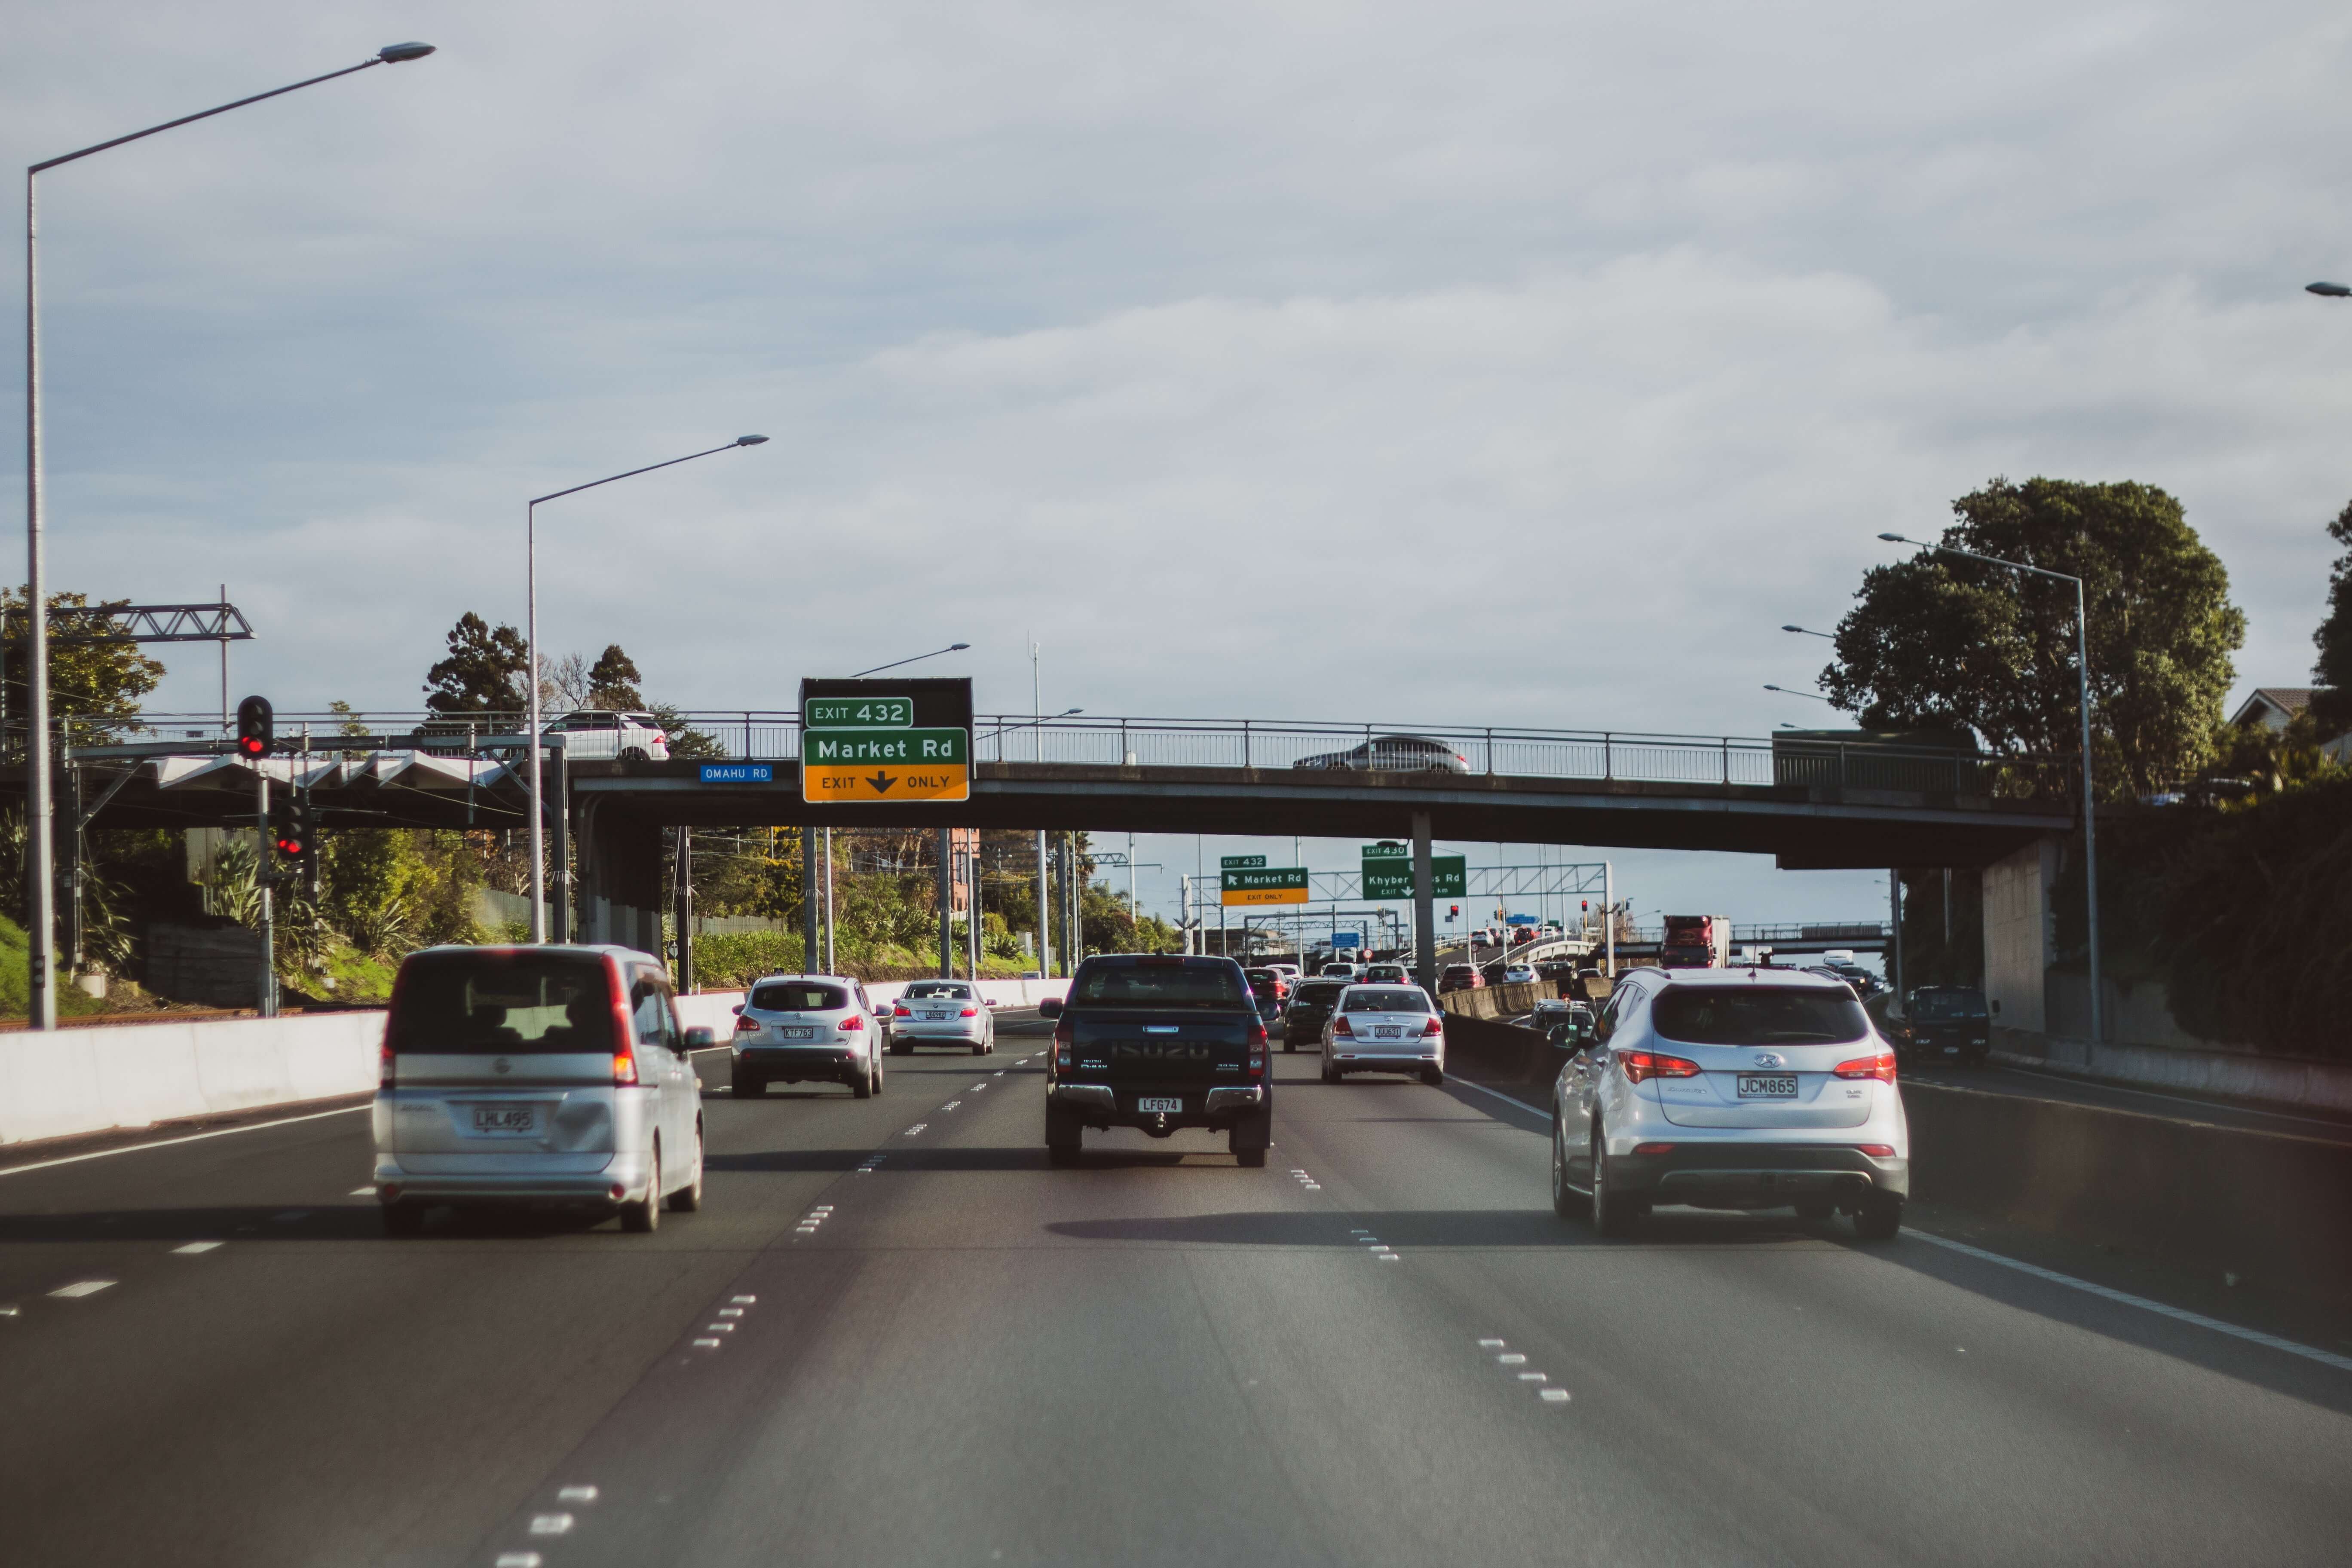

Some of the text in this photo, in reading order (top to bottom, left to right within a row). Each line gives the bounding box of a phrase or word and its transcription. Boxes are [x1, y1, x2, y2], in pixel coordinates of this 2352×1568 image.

[815, 704, 903, 721] EXIT 432
[819, 739, 952, 758] Market Rd
[706, 769, 767, 778] OMAHU RD
[822, 776, 950, 789] EXIT ONLY
[1243, 857, 1263, 865] 432
[1245, 874, 1302, 884] Market Rd
[1369, 876, 1409, 886] Khyber
[1446, 873, 1460, 882] Rd
[1111, 1041, 1209, 1060] ISUZU
[1741, 1080, 1795, 1093] JCM865
[1143, 1099, 1177, 1111] LFG74
[475, 1112, 530, 1126] LHL495
